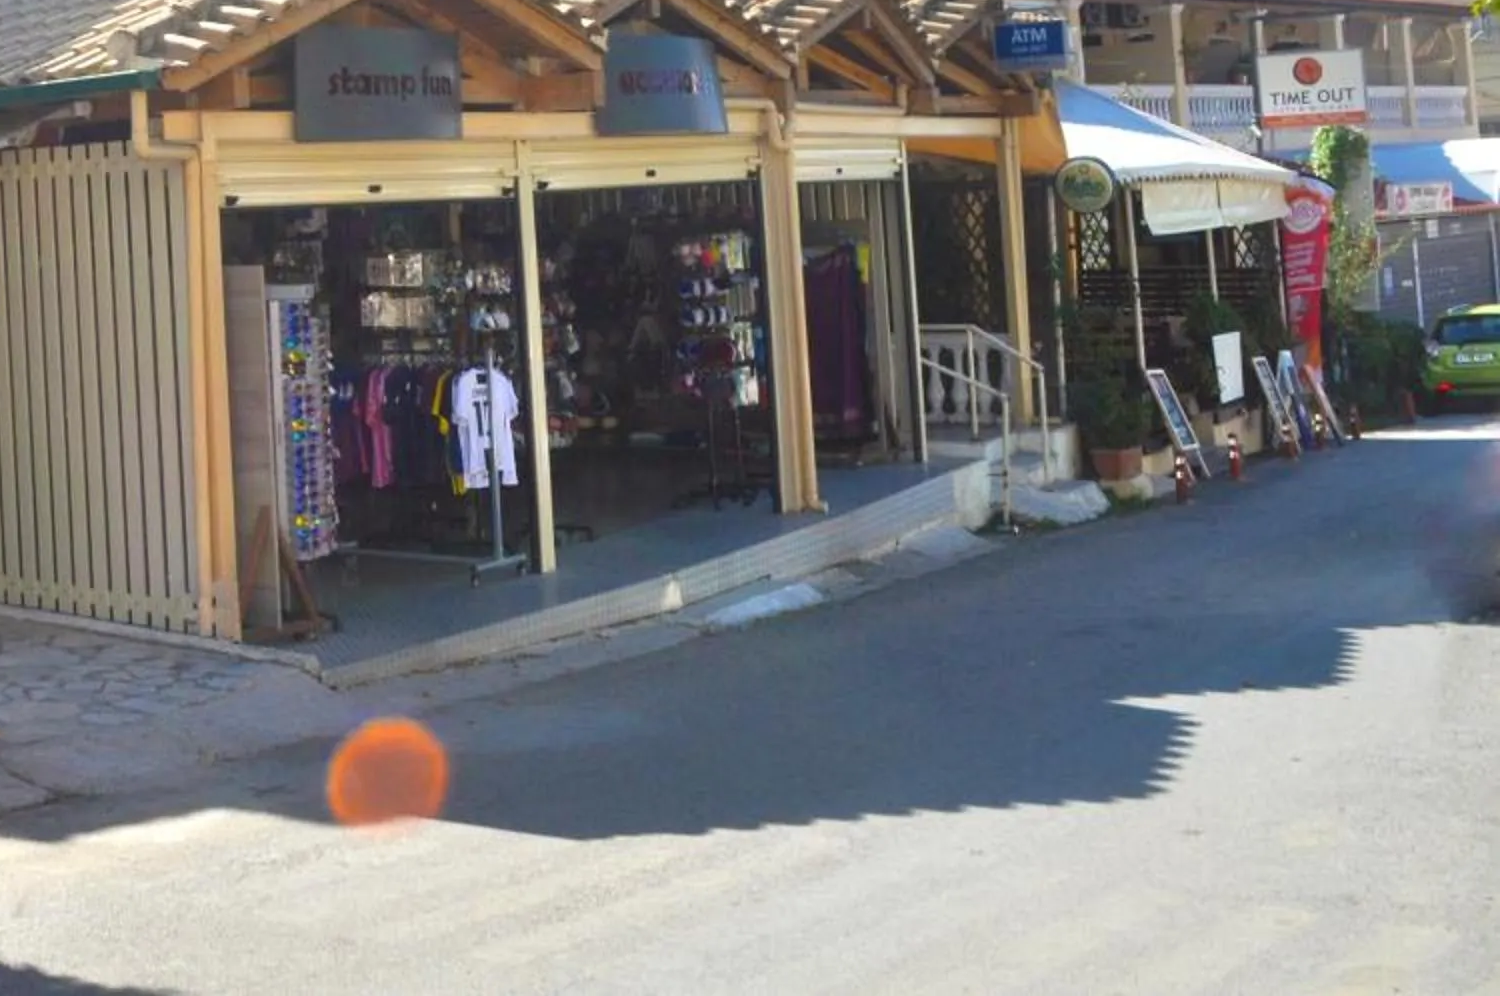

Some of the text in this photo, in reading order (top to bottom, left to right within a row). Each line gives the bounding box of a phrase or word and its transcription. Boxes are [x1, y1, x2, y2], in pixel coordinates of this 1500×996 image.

[1012, 27, 1047, 44] ATM
[328, 65, 452, 101] stamp fun
[1270, 87, 1356, 105] TIME OUT
